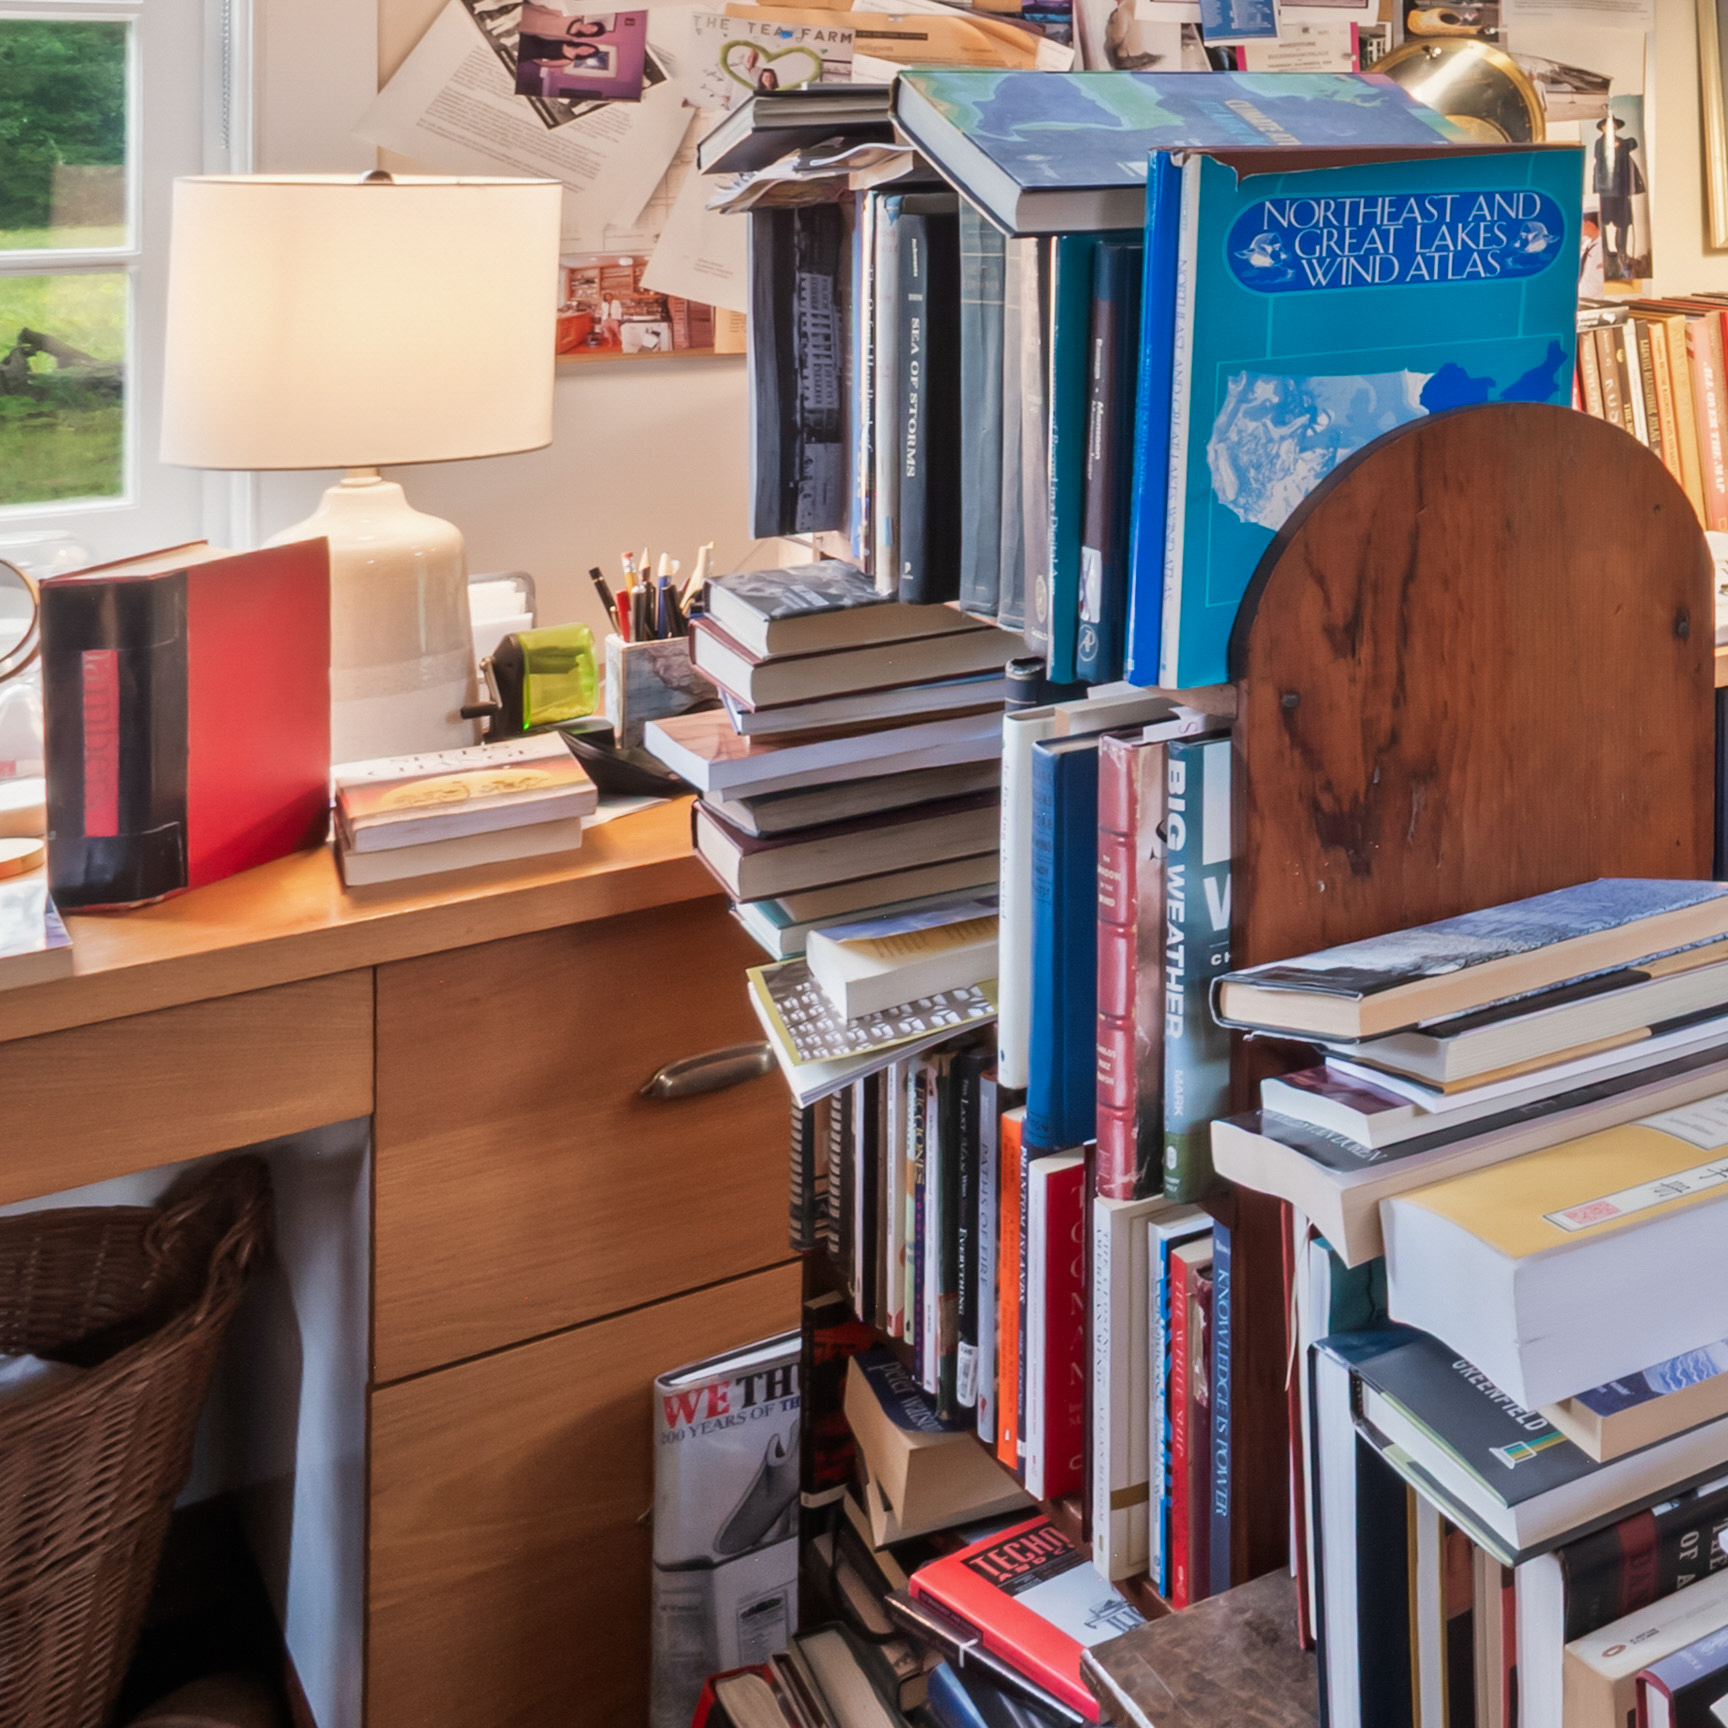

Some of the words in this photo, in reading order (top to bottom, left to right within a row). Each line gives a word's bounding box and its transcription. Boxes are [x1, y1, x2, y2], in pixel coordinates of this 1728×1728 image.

[693, 14, 730, 32] THE
[747, 21, 783, 38] TEA
[800, 27, 853, 45] FARM
[1263, 194, 1460, 231] NORTHEAST
[1468, 192, 1541, 221] AND
[1294, 224, 1404, 259] GREAT
[1415, 221, 1508, 253] LAKES
[1301, 255, 1400, 286] WIND
[1405, 251, 1501, 282] ATLAS
[909, 316, 921, 354] SEA
[908, 360, 920, 388] OF
[904, 392, 919, 478] STORMS
[1165, 757, 1188, 853] BIG
[1165, 864, 1187, 1041] WEATHER
[1173, 1069, 1185, 1117] MARK
[981, 1143, 989, 1206] PATHS
[1020, 1146, 1028, 1227] PHANTOM
[981, 1212, 988, 1237] OF
[980, 1247, 988, 1286] FIRE
[1216, 1268, 1229, 1412] KNOWLEDGE
[663, 1380, 730, 1429] WE
[736, 1363, 800, 1408] TH
[1451, 1357, 1550, 1434] GREENFIELD
[689, 1412, 746, 1438] YEARS
[750, 1404, 774, 1419] OF
[1217, 1416, 1228, 1433] IS
[1215, 1438, 1228, 1517] POWER
